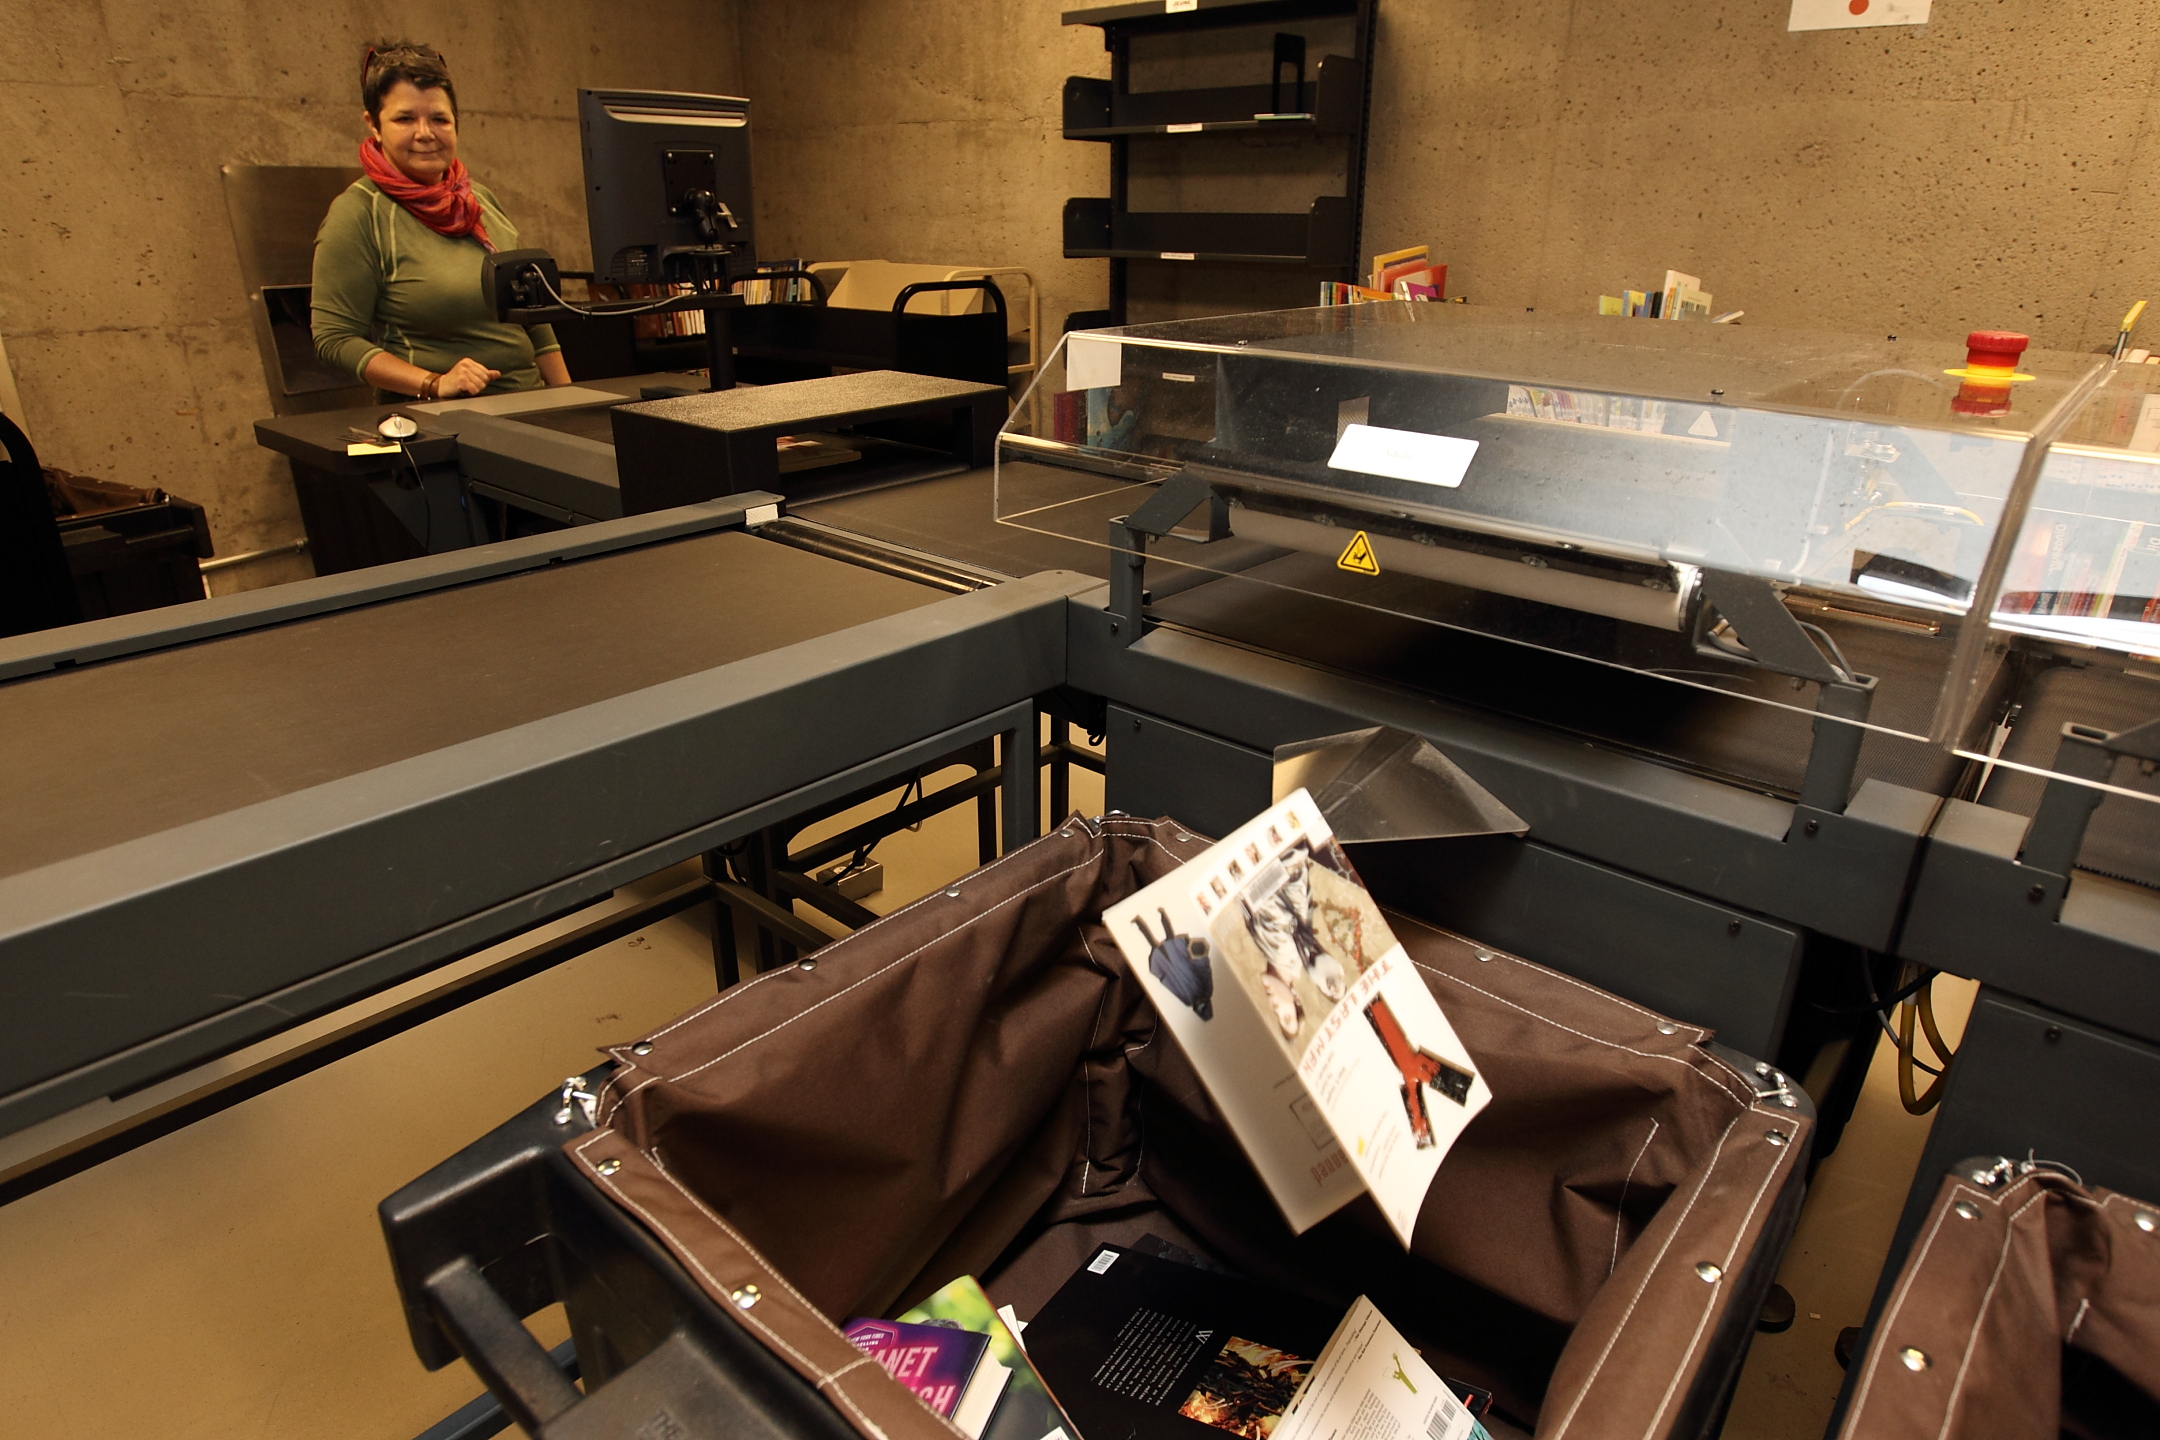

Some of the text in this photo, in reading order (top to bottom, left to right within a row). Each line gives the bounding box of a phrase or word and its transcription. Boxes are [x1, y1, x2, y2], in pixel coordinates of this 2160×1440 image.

[1360, 960, 1393, 997] THE
[1327, 995, 1358, 1042] LAST
[1303, 1038, 1326, 1076] MAN
